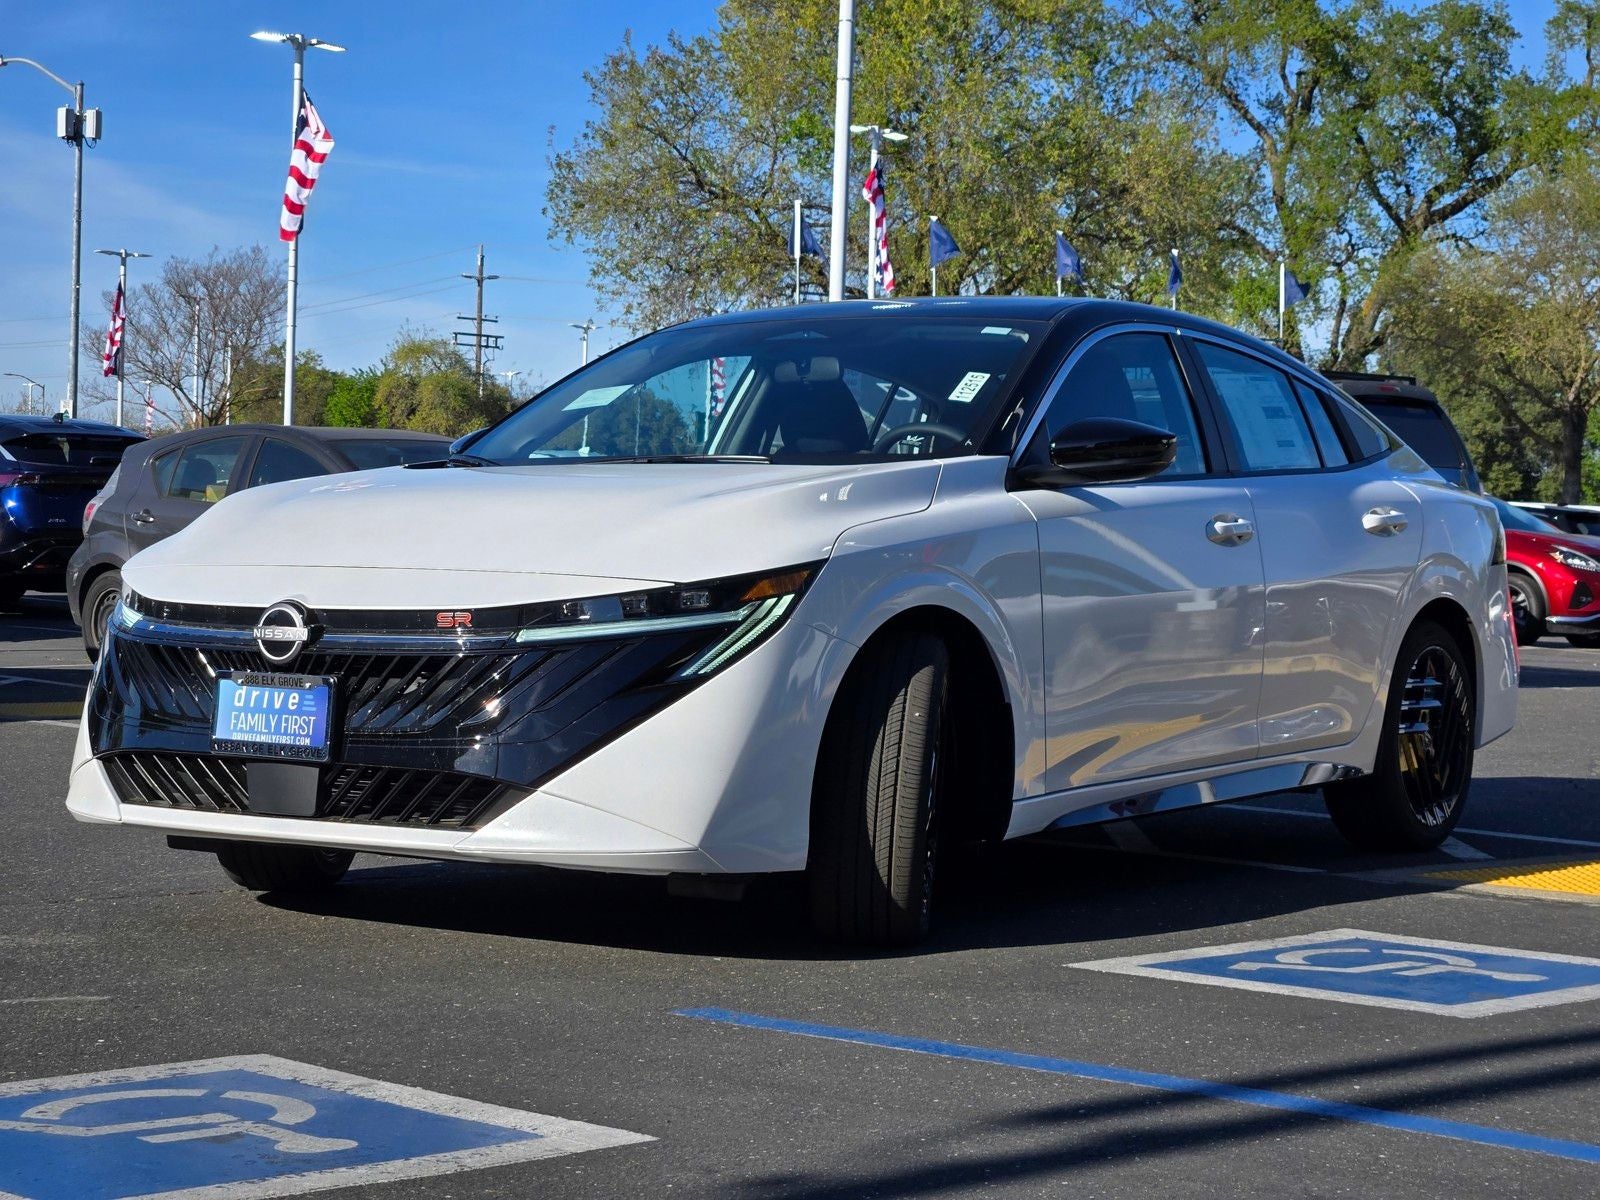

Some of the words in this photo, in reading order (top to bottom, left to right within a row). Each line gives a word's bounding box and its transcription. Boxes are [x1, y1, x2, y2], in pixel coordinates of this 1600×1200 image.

[437, 612, 472, 627] SR
[253, 628, 308, 641] NISSAN
[262, 675, 276, 686] ELK
[279, 676, 303, 687] GROVE
[234, 686, 299, 710] drive
[230, 712, 278, 732] FAMILY
[281, 715, 316, 735] FIRST
[232, 732, 311, 745] DRIVEFAMILYFIRST.COM
